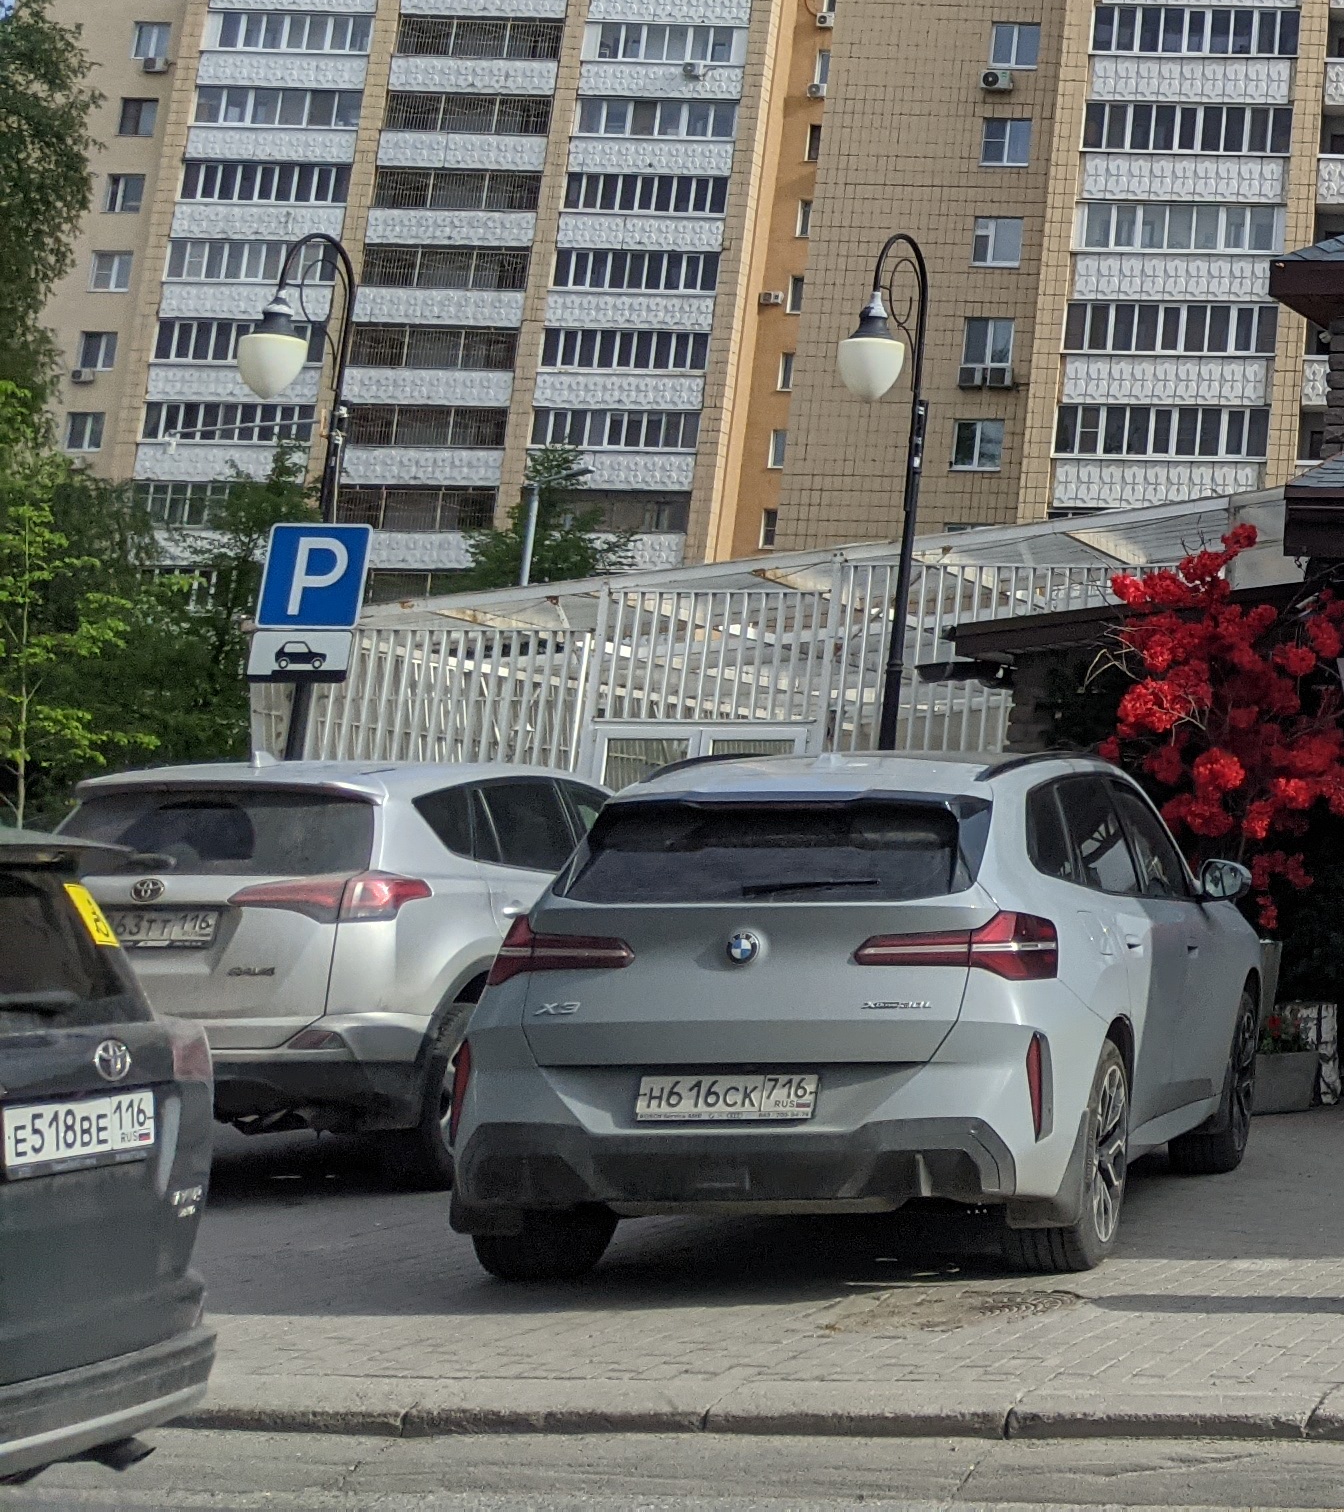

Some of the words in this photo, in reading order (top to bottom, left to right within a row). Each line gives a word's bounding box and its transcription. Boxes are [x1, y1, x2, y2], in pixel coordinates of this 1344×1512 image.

[286, 536, 349, 616] P
[107, 912, 171, 937] 63ТТ
[179, 912, 212, 930] 116
[534, 1002, 581, 1016] X3
[766, 1077, 807, 1100] 716
[774, 1100, 795, 1108] RUS
[13, 1108, 109, 1158] Е518ВЕ
[113, 1097, 147, 1131] 116
[121, 1132, 139, 1143] RUS
